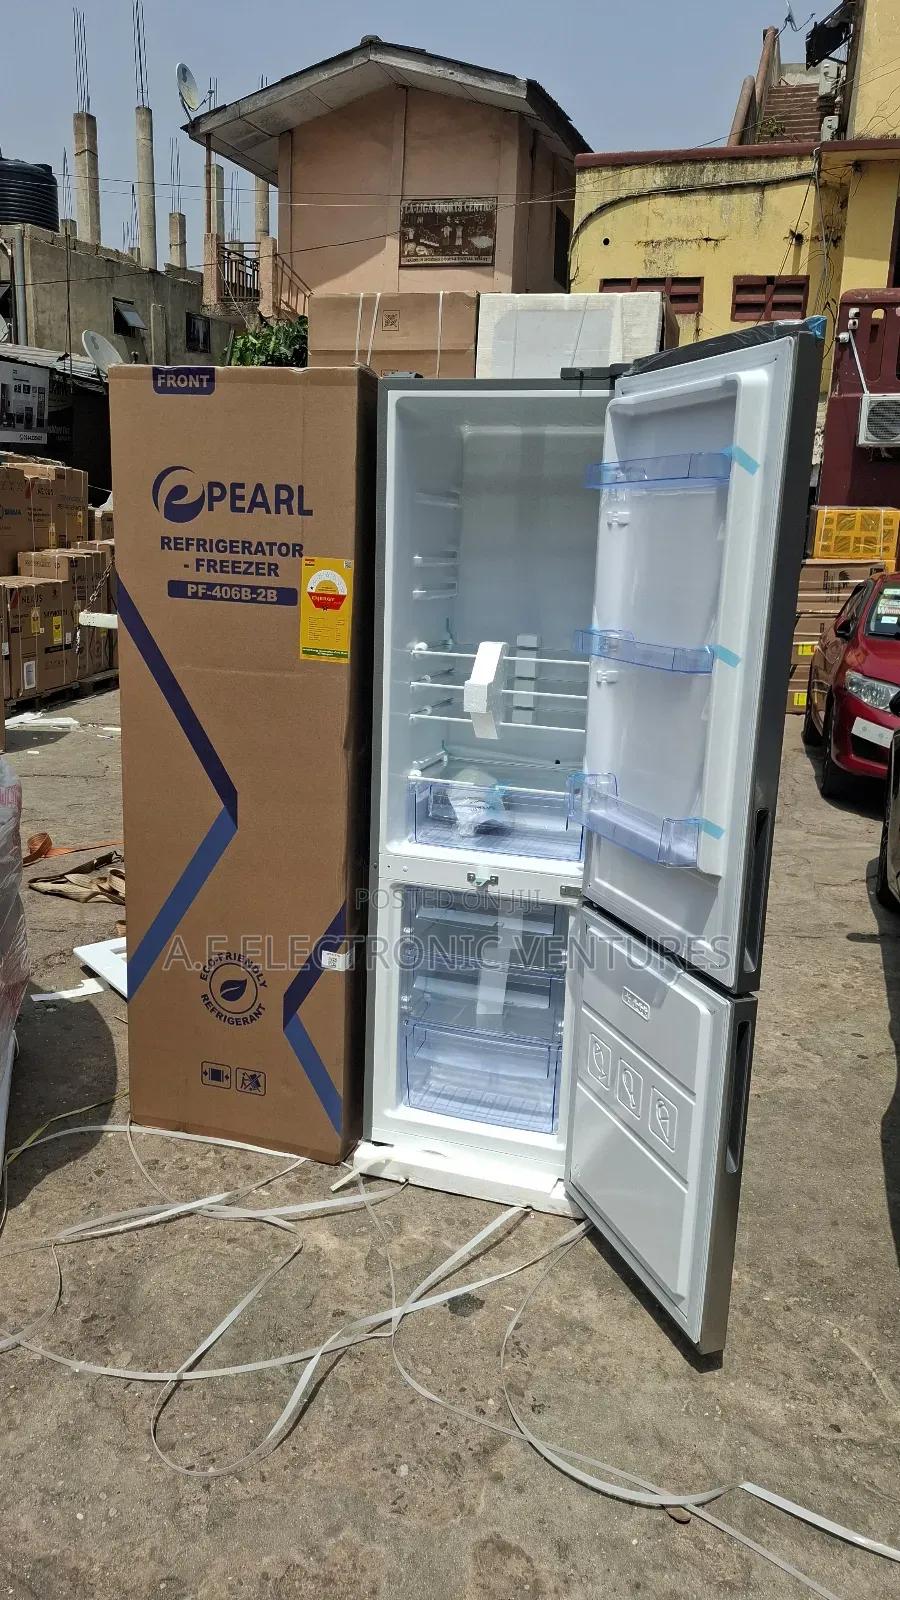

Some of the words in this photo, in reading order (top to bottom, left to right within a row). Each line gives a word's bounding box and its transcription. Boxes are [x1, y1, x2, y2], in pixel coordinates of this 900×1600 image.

[434, 202, 463, 214] SPORTS
[156, 374, 210, 388] FRONT
[207, 481, 313, 516] PEARL
[160, 535, 304, 558] REFRIGERATOR
[195, 558, 280, 577] FREEZER
[187, 584, 278, 602] PF-406B-2B
[200, 951, 268, 988] ECO-FRIENDLY
[200, 993, 266, 1026] REFRIGERANT
